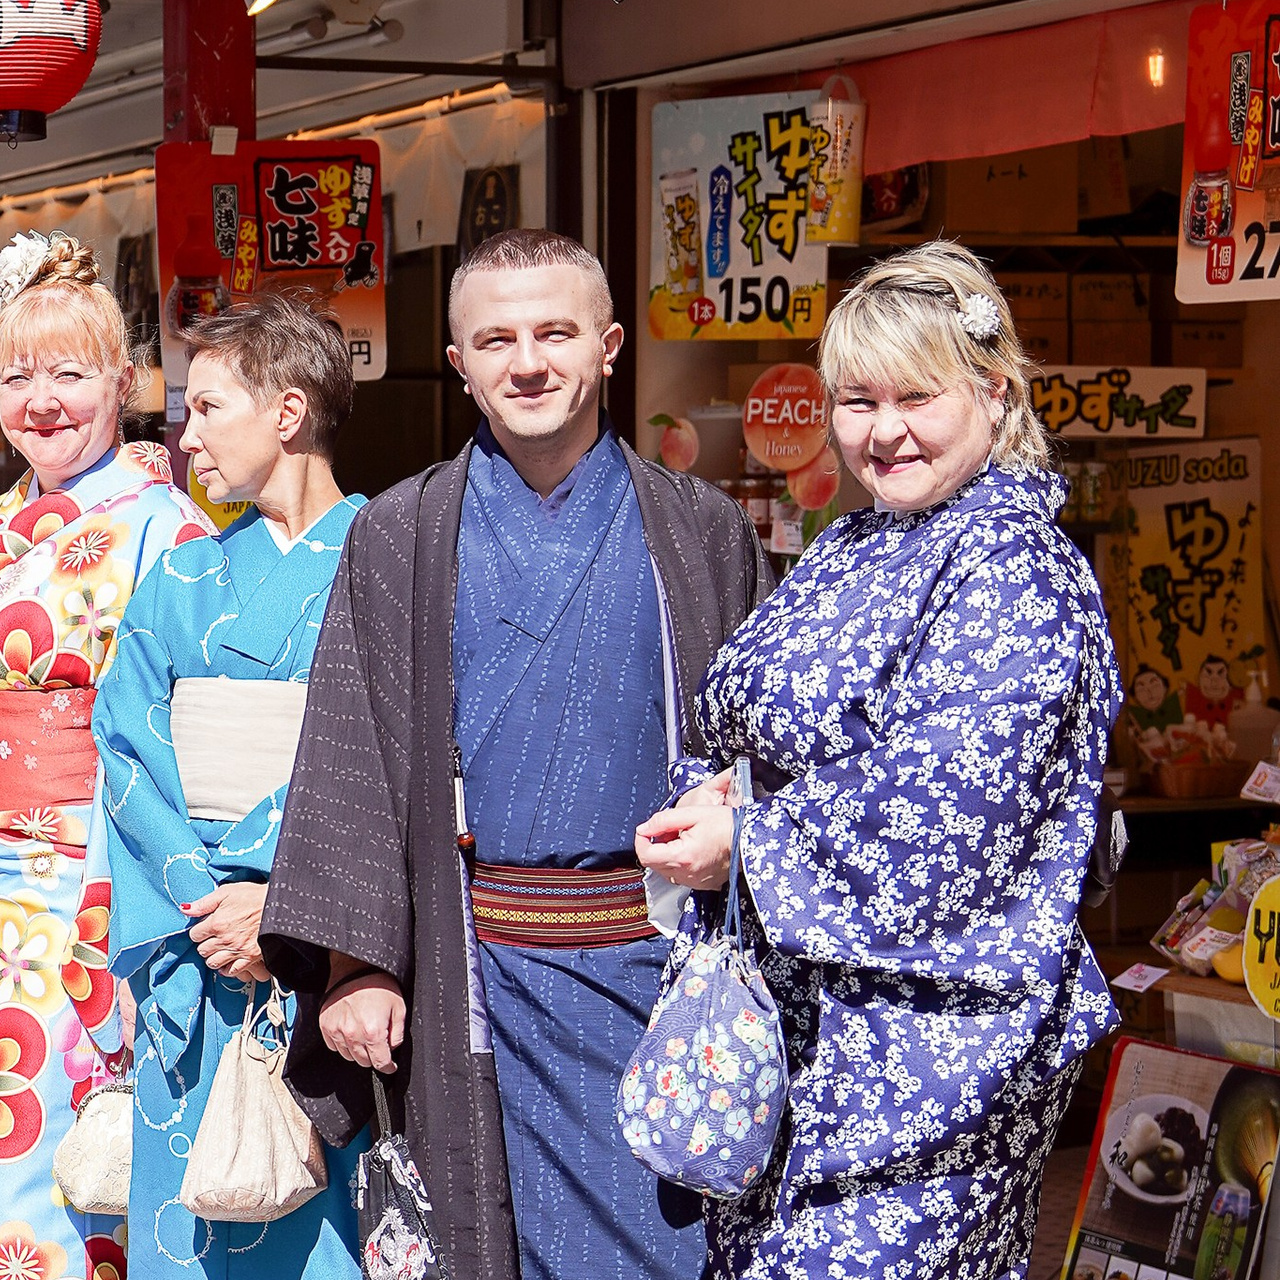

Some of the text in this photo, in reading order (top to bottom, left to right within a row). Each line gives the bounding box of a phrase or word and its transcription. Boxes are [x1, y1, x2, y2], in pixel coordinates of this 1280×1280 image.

[728, 130, 768, 266] サイダー
[763, 107, 810, 262] ゆず
[265, 165, 322, 267] 七味
[691, 303, 714, 321] 1本
[719, 276, 812, 323] 150 円
[349, 340, 371, 365] 円
[746, 398, 827, 425] PEACH
[765, 440, 802, 457] Honey
[1183, 449, 1249, 483] soda
[1165, 498, 1230, 637] ゆず
